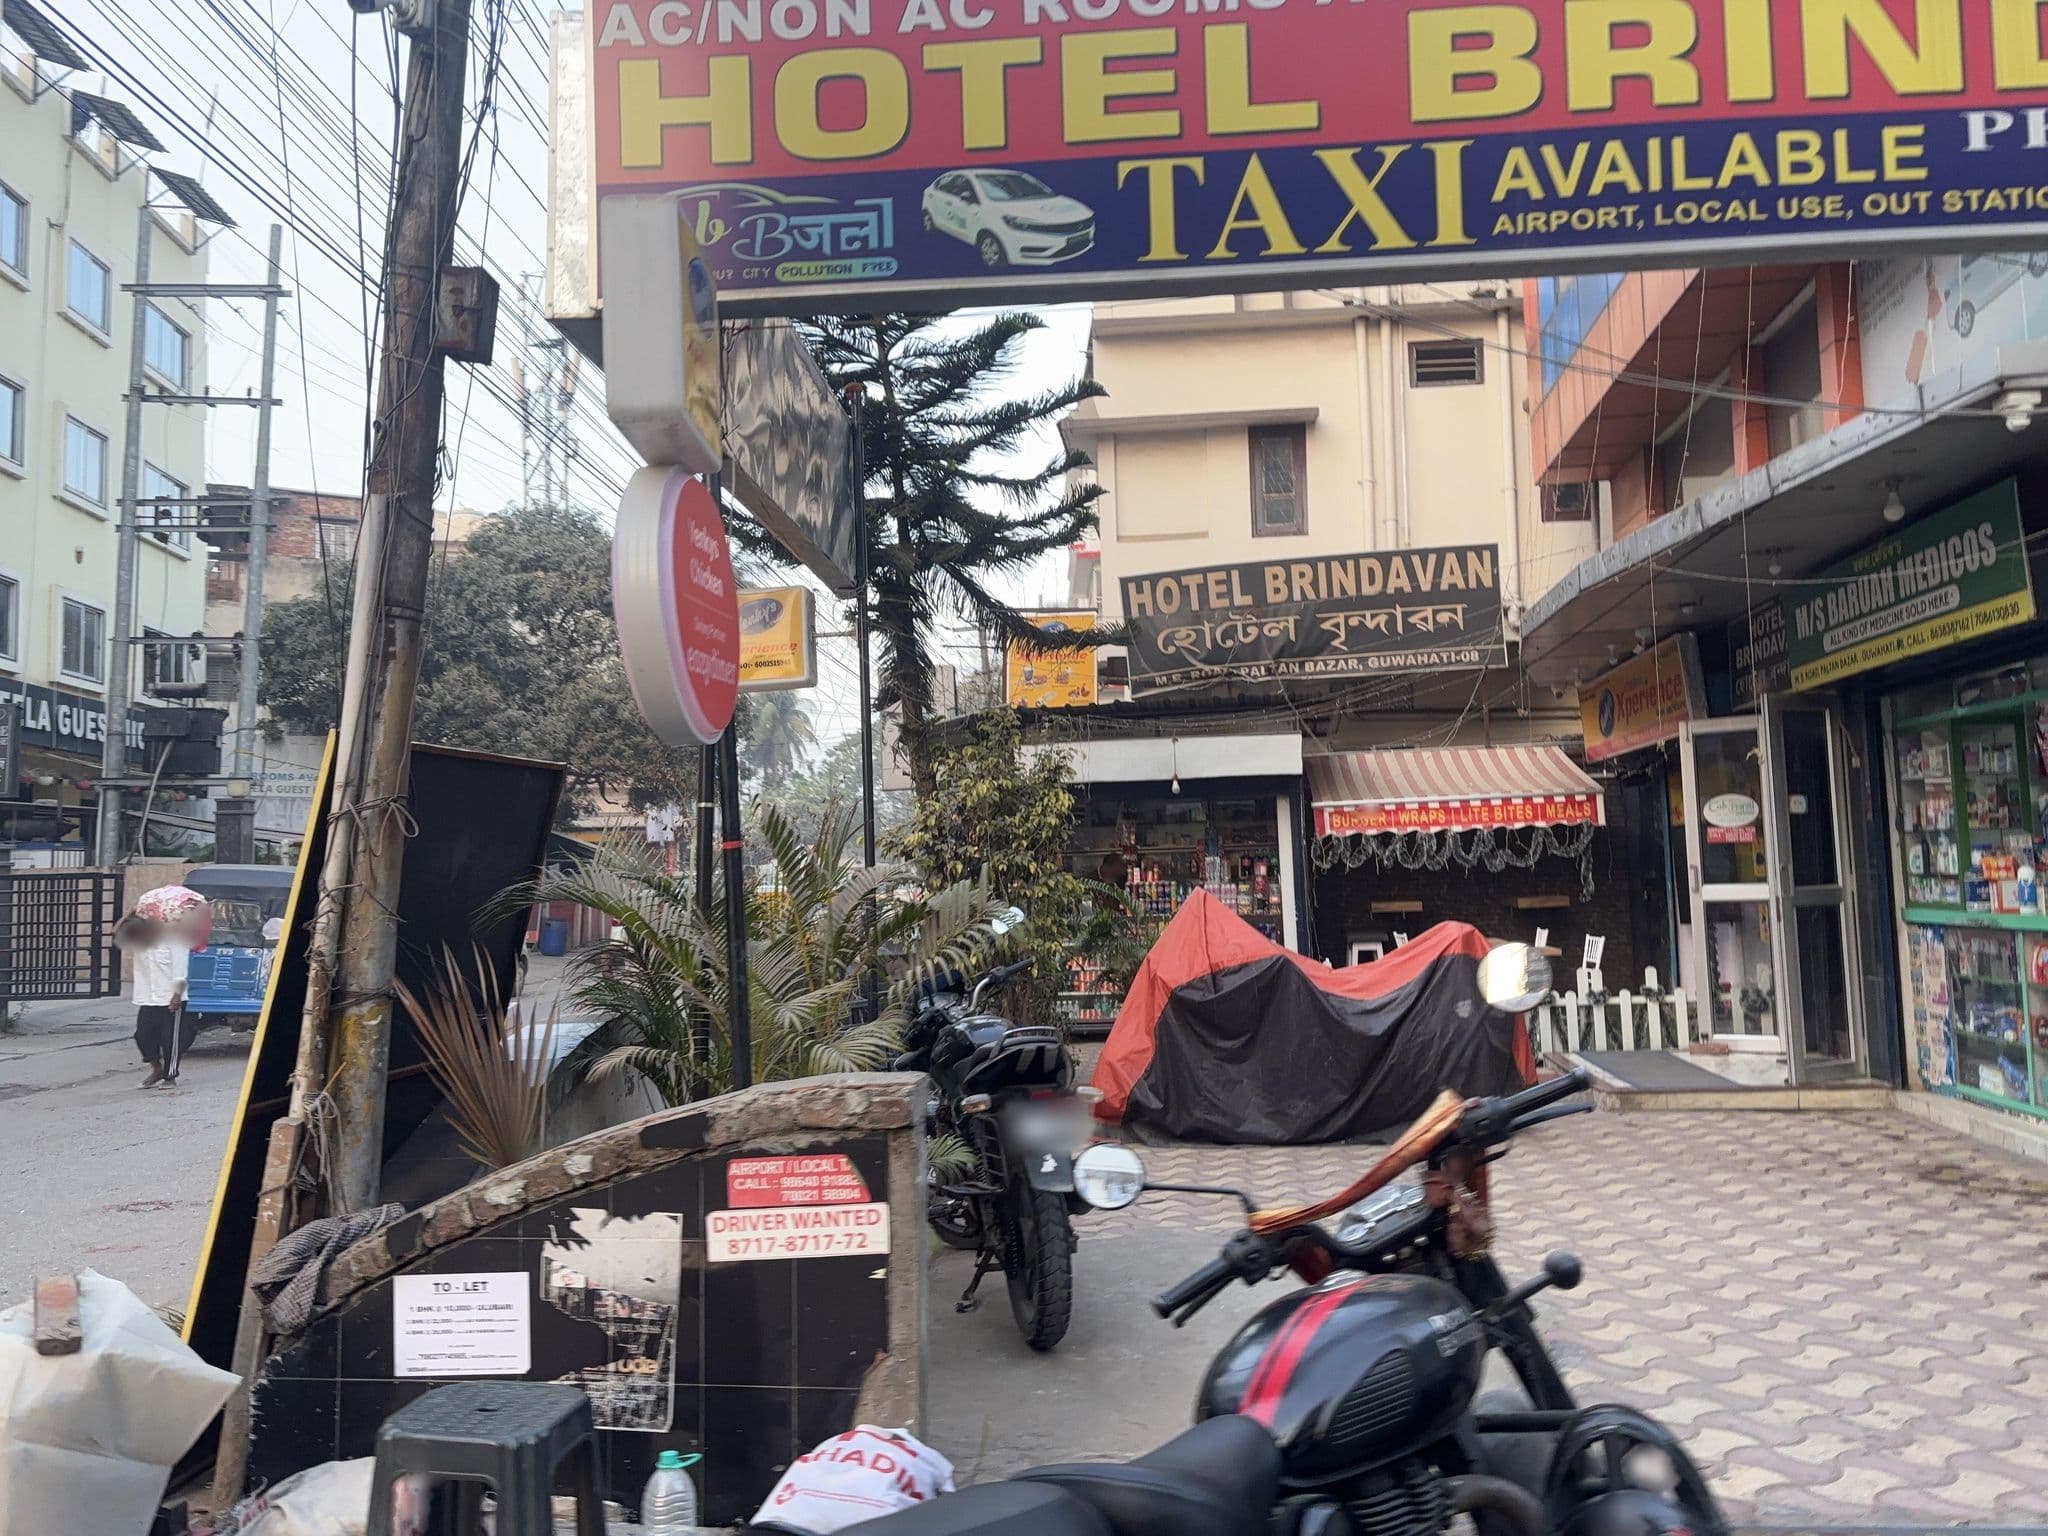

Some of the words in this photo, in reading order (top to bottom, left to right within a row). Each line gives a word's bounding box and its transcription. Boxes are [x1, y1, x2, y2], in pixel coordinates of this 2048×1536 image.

[597, 1, 872, 48] AC/NON
[896, 0, 995, 34] AC
[617, 23, 1322, 171] HOTEL
[1116, 139, 1478, 262] TAXI
[1490, 123, 1930, 204] AVAILABLE
[1492, 204, 1645, 237] AIRPORT,
[1653, 199, 1767, 228] LOCAL
[1777, 196, 1853, 221] USE,
[1862, 190, 1934, 217] OUT
[1127, 569, 1253, 619] HOTEL
[1264, 549, 1494, 605] BRINDAVAN
[1795, 594, 1826, 641] M/S
[1826, 564, 1896, 627] BARUAH
[1896, 520, 1997, 600] MEDICOS
[1303, 658, 1363, 674] BAZAR,
[1367, 650, 1480, 668] GUWAHATI-08
[57, 703, 107, 743] GUES
[1398, 807, 1446, 826] WRAPS
[1460, 805, 1492, 823] LITE
[1494, 803, 1534, 822] BITES
[1545, 801, 1592, 819] MEALS
[712, 1212, 789, 1234] DRIVER
[790, 1208, 882, 1230] WANTED
[432, 1282, 453, 1292] TO
[463, 1281, 489, 1291] LET
